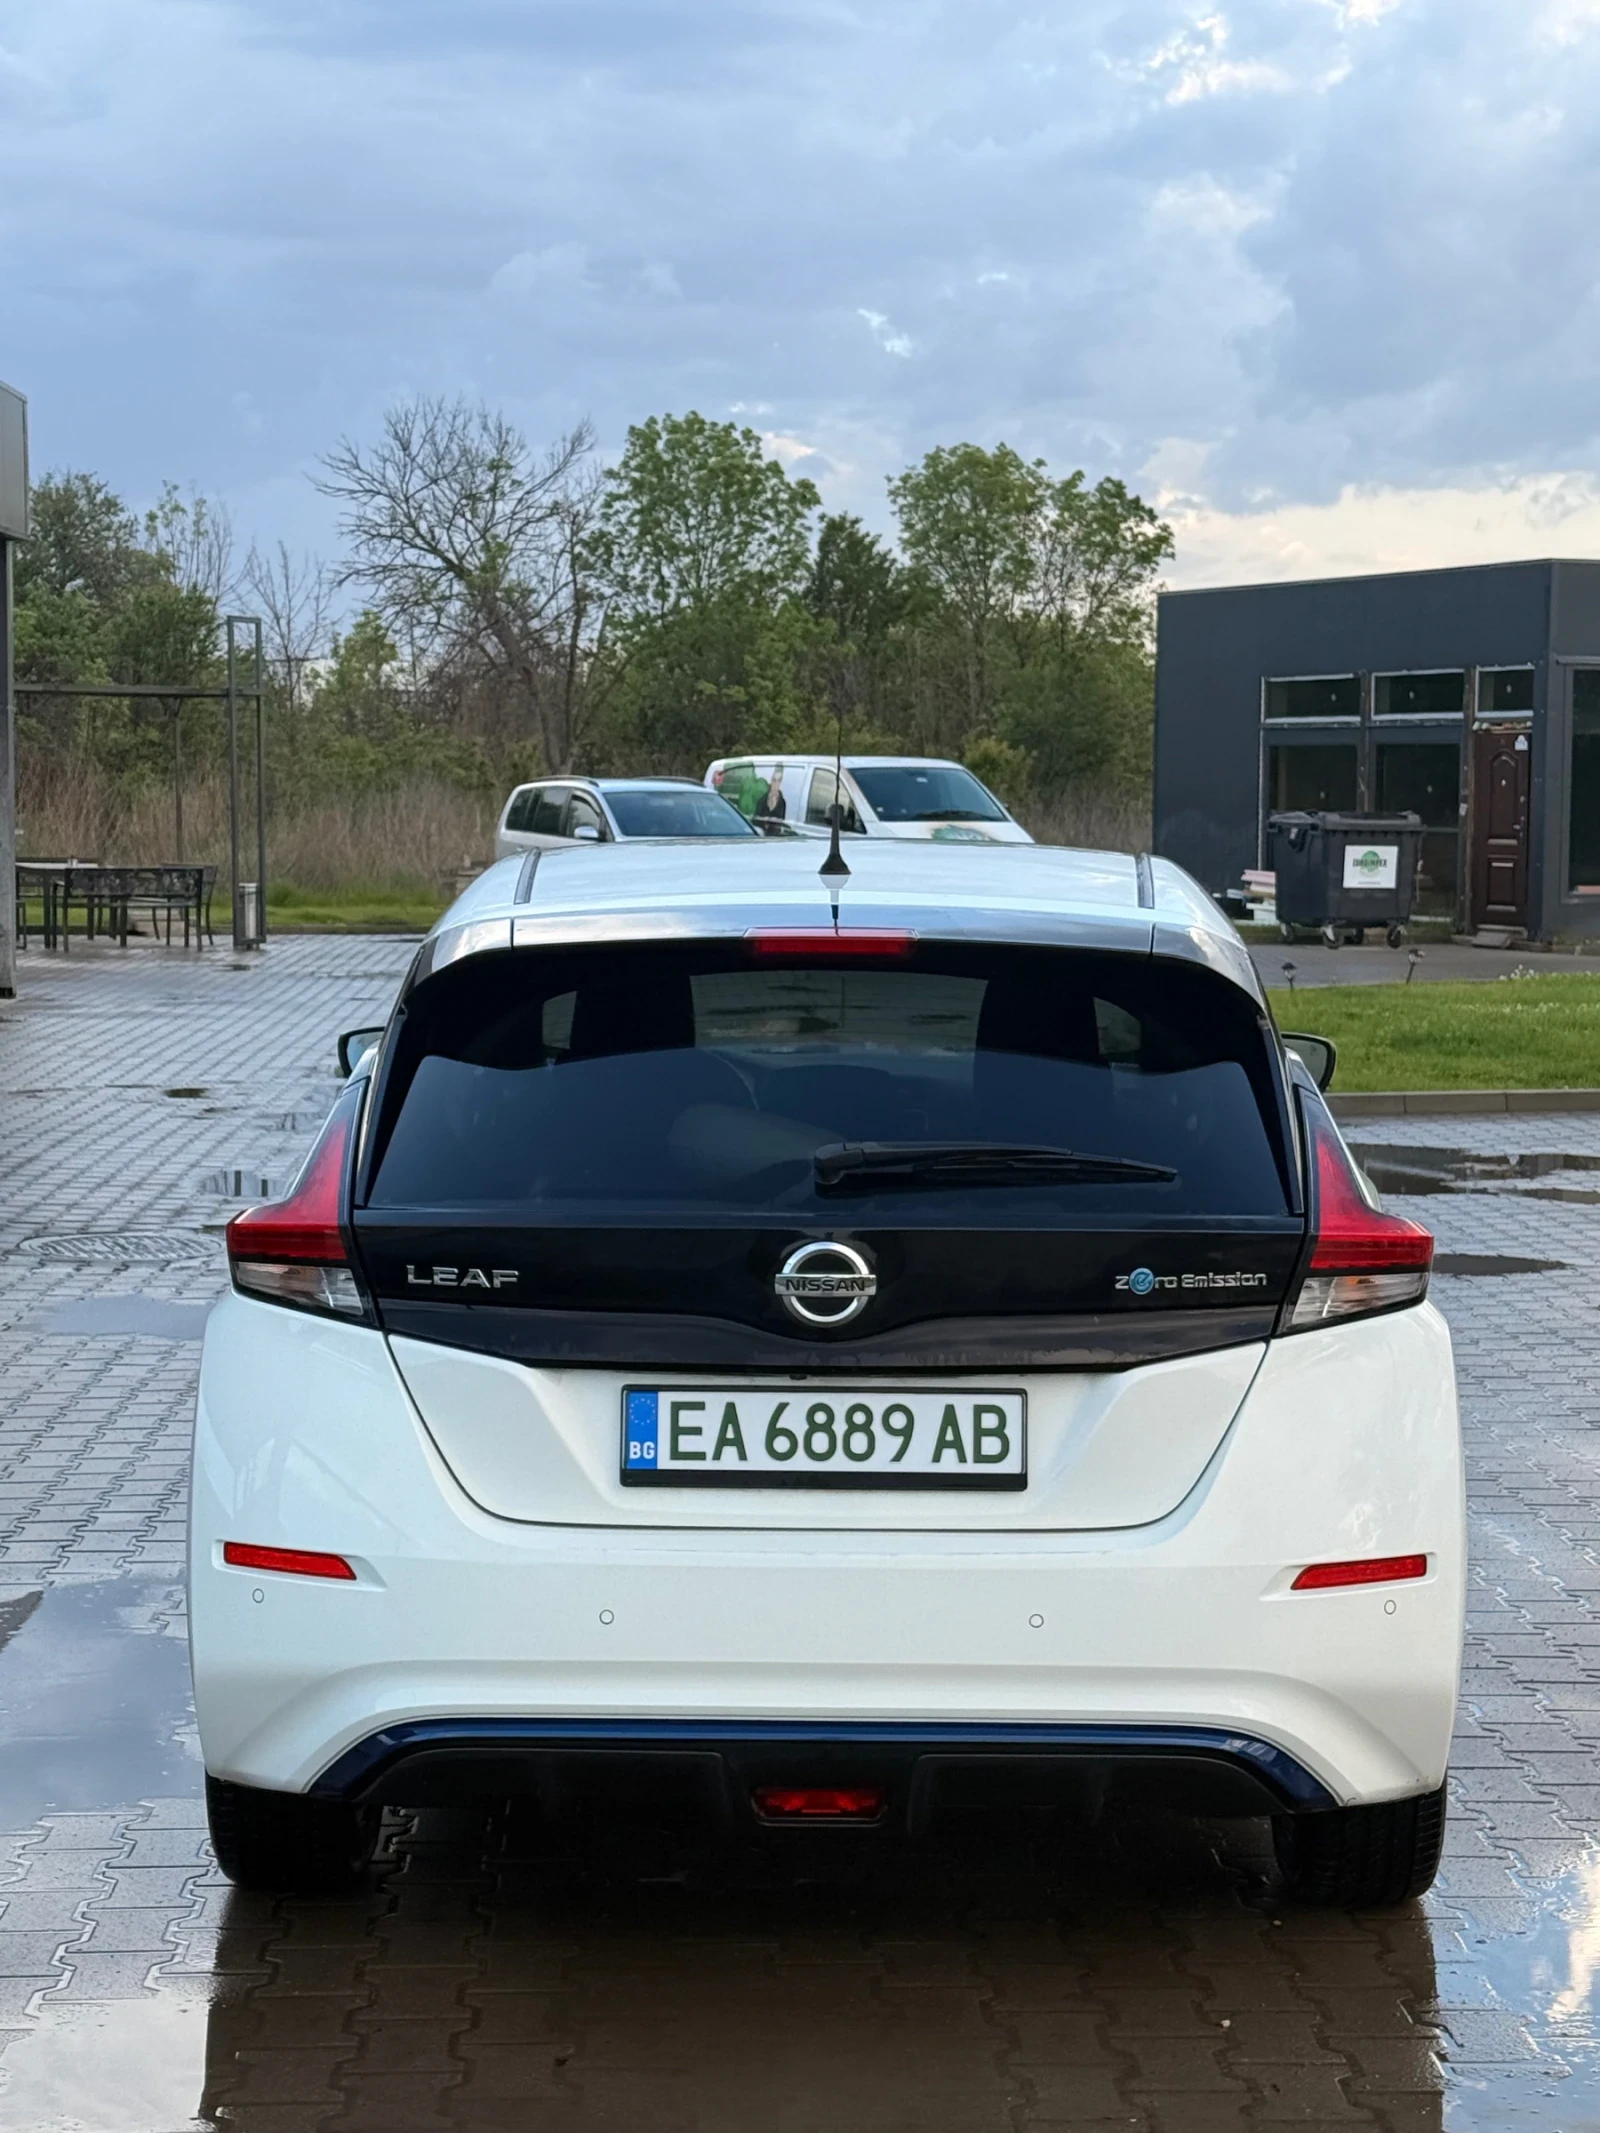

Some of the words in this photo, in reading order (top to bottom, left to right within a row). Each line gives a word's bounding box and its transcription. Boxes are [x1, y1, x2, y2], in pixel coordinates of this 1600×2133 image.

[405, 1265, 519, 1288] LEAF
[785, 1279, 865, 1292] NISSAN
[1181, 1271, 1268, 1289] Emission
[669, 1401, 747, 1461] EA
[765, 1402, 914, 1463] 6889
[932, 1404, 1011, 1464] AB
[629, 1441, 655, 1460] BG
